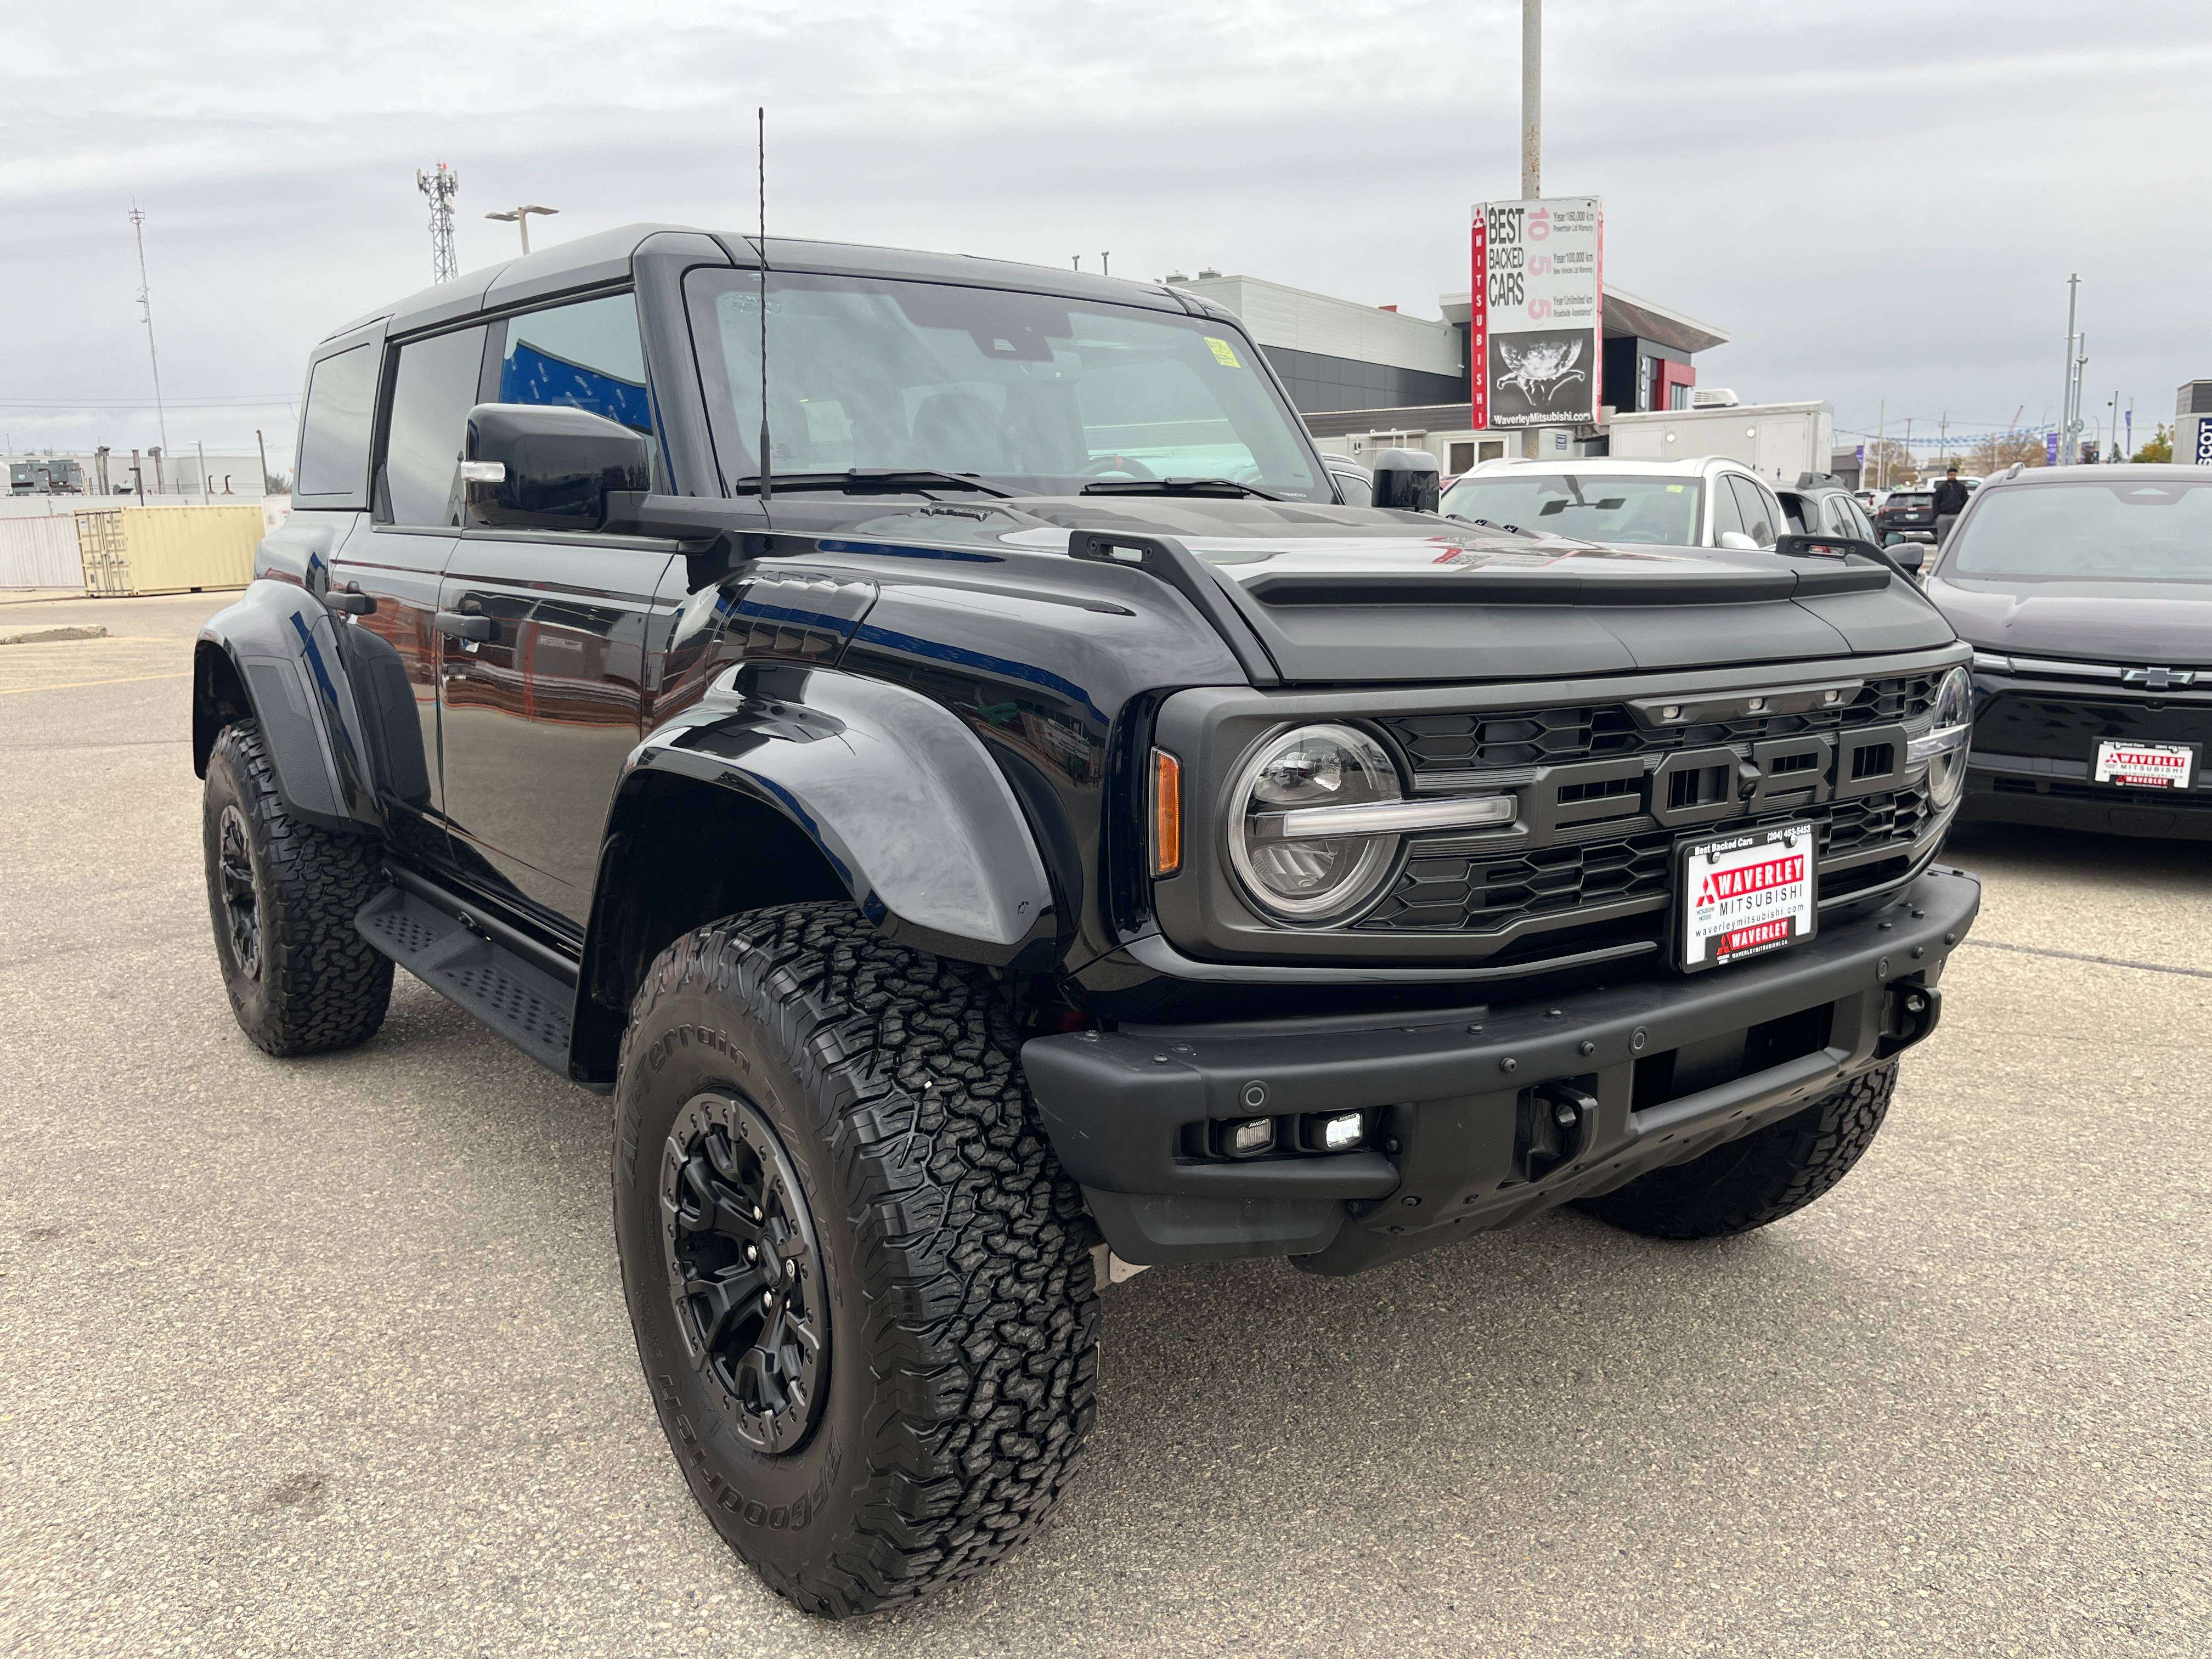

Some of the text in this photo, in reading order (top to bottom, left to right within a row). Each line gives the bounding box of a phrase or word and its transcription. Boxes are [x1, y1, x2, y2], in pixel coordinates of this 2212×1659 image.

[1488, 208, 1524, 245] BEST
[1527, 207, 1550, 241] 10
[1553, 212, 1565, 222] Year
[1587, 211, 1594, 221] km
[1489, 247, 1524, 270] BACKED
[1528, 255, 1552, 276] 5
[1553, 253, 1565, 263] Year
[1585, 252, 1593, 262] km
[1489, 272, 1524, 307] CARS
[1528, 298, 1552, 320] 5
[1553, 295, 1593, 306] Year Unlimited km
[1493, 411, 1590, 426] WaverleyMitsubishi.com
[2120, 754, 2184, 767] WAVERLEY
[2120, 764, 2182, 774] MITSUBISHI
[1530, 724, 1908, 848] FORD
[2126, 775, 2168, 786] WAVERLEY
[1695, 837, 1753, 856] Best Backed Cars
[1767, 830, 1782, 843] (204)
[1718, 857, 1803, 896] WAVERLEY
[1719, 884, 1803, 916] MITSUBISHI
[1696, 906, 1714, 915] MITSUBISHI
[1696, 904, 1803, 937] waverleymitsubishi.com
[1732, 921, 1788, 948] WAVERLEY
[1248, 1118, 1269, 1128] RIGID
[1338, 1111, 1361, 1122] RIGID
[659, 1374, 842, 1533] BFGoodrich
